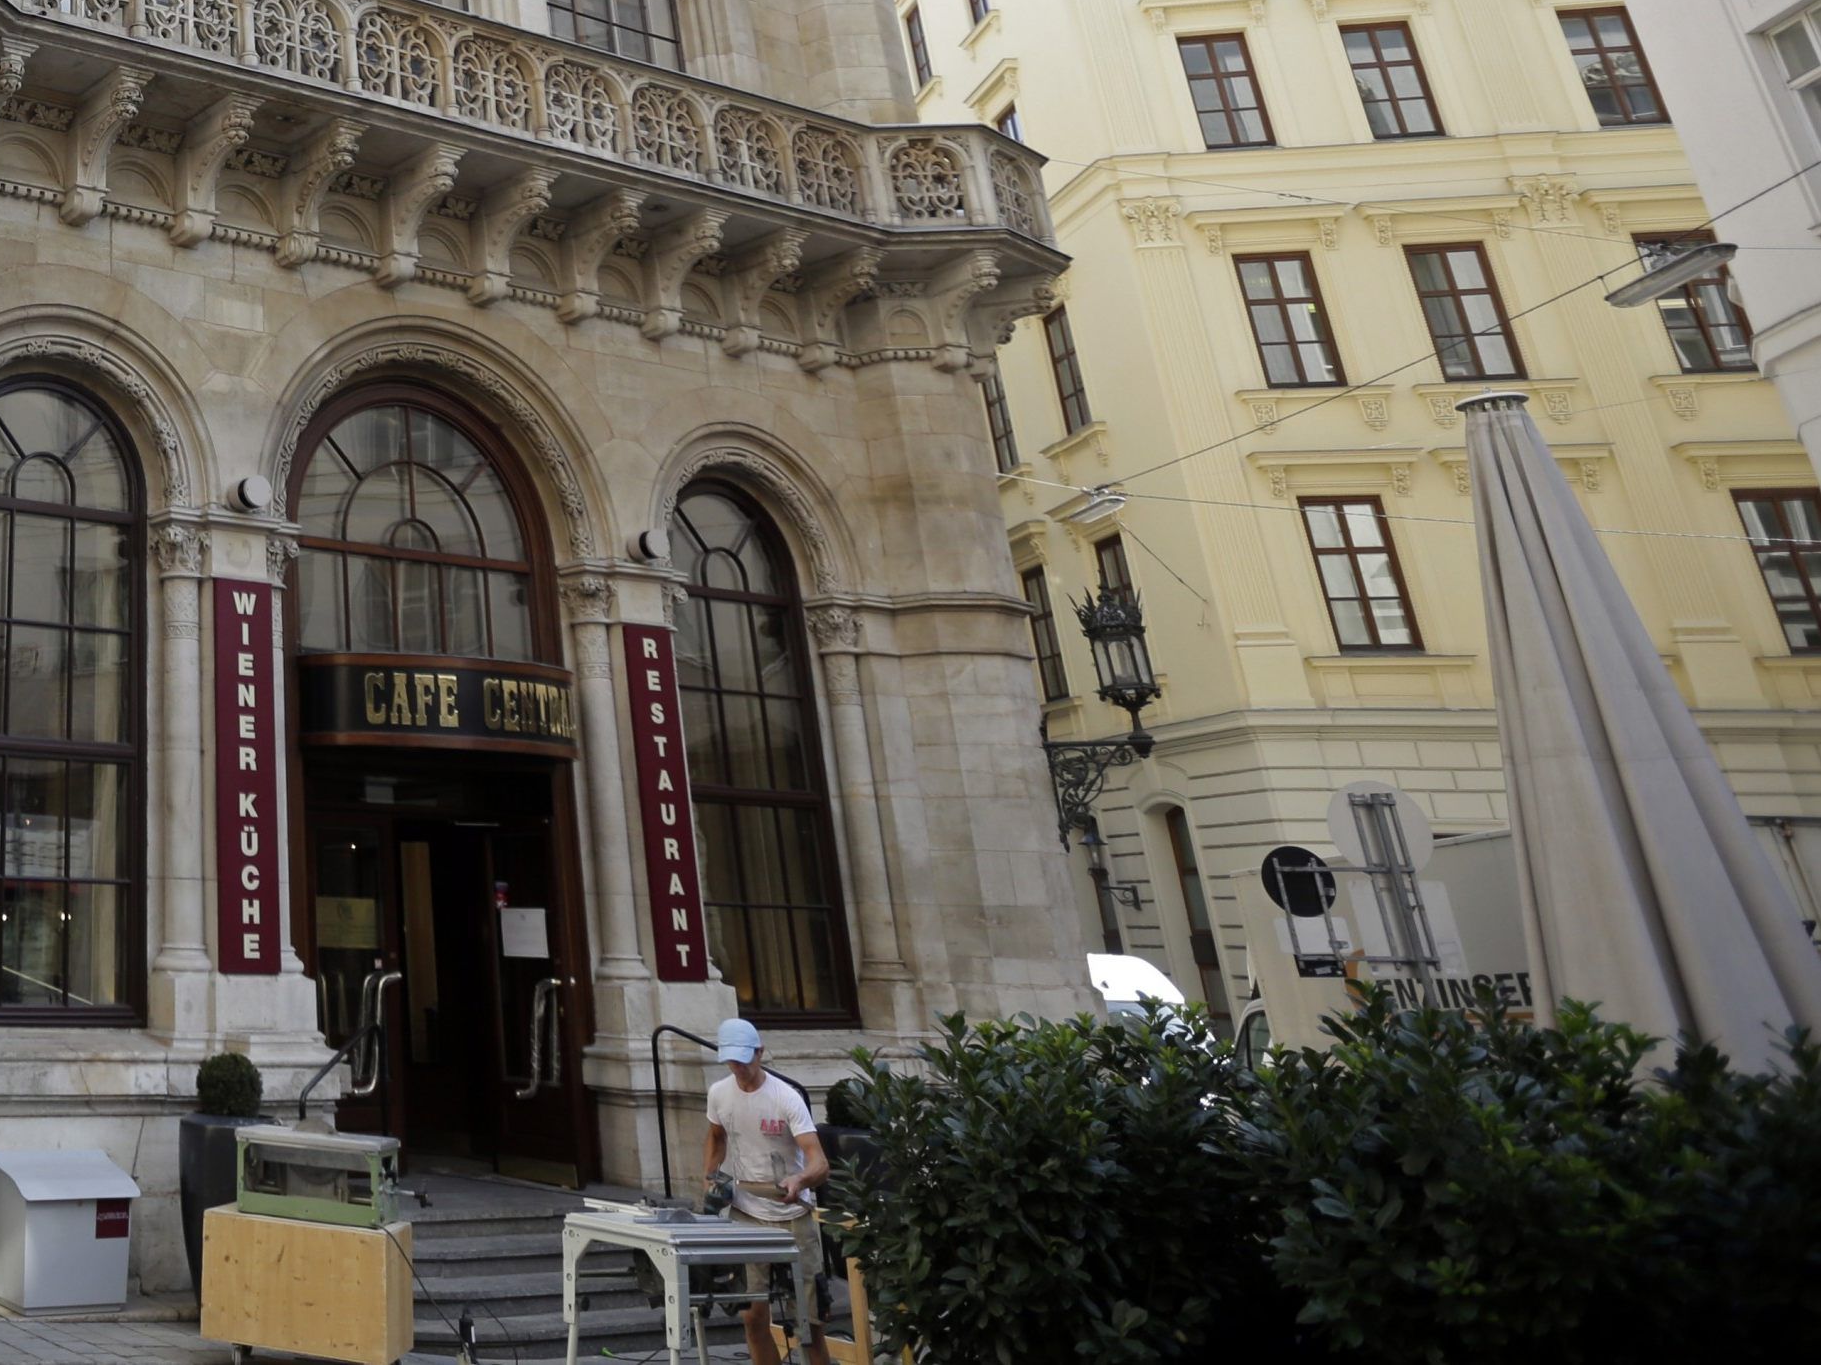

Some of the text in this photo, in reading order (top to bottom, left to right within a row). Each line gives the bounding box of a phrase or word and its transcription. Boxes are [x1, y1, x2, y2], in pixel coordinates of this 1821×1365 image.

[233, 591, 261, 959] WIENER KÜCHE
[364, 672, 459, 728] CAFE
[642, 637, 691, 968] RESTAURANT
